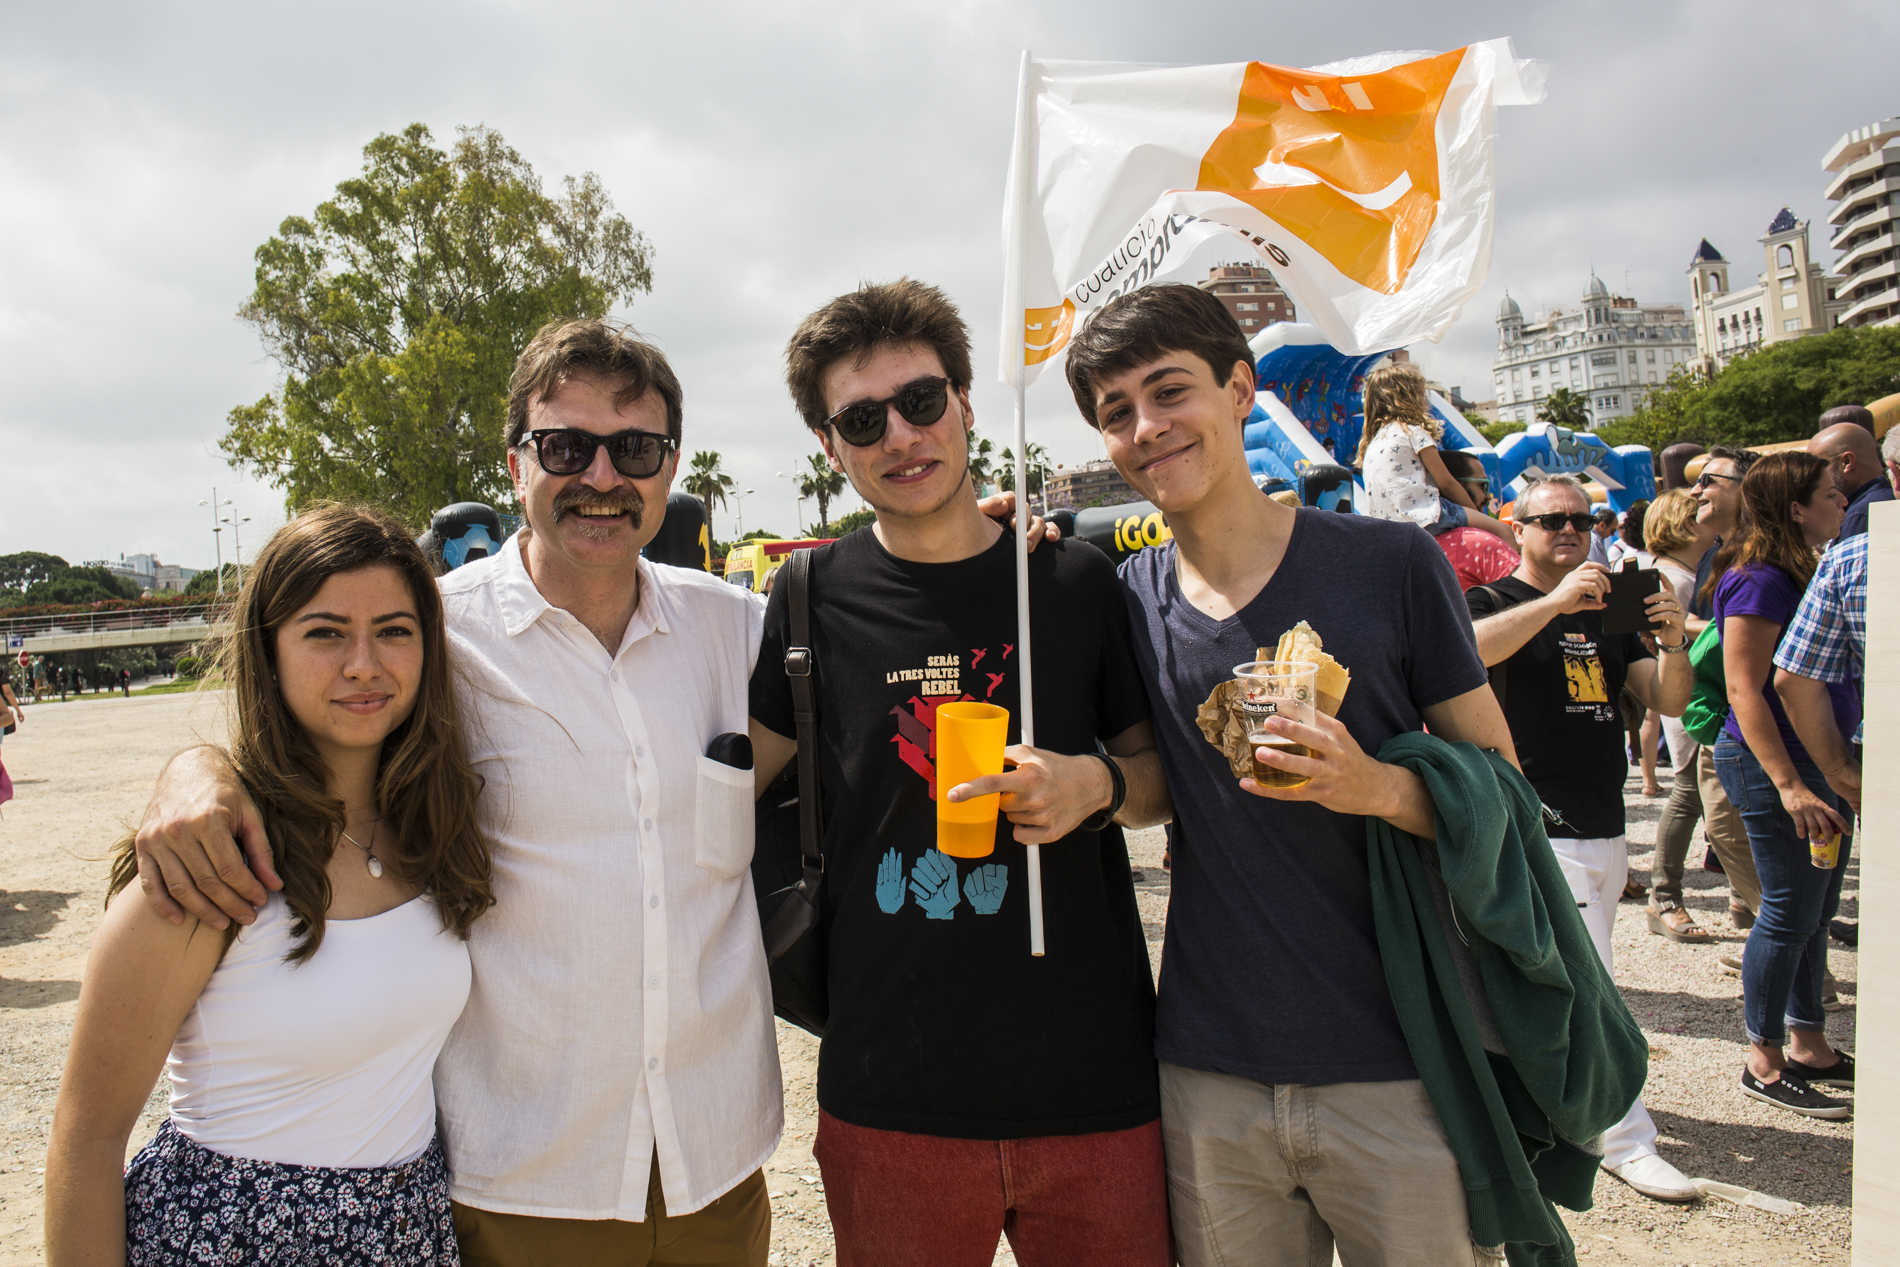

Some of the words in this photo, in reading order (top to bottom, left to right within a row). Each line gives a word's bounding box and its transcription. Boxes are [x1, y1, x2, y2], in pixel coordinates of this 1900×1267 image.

[886, 671, 899, 684] LA
[899, 668, 924, 682] TRES
[924, 667, 961, 680] VOLTES
[921, 680, 962, 696] REBEL
